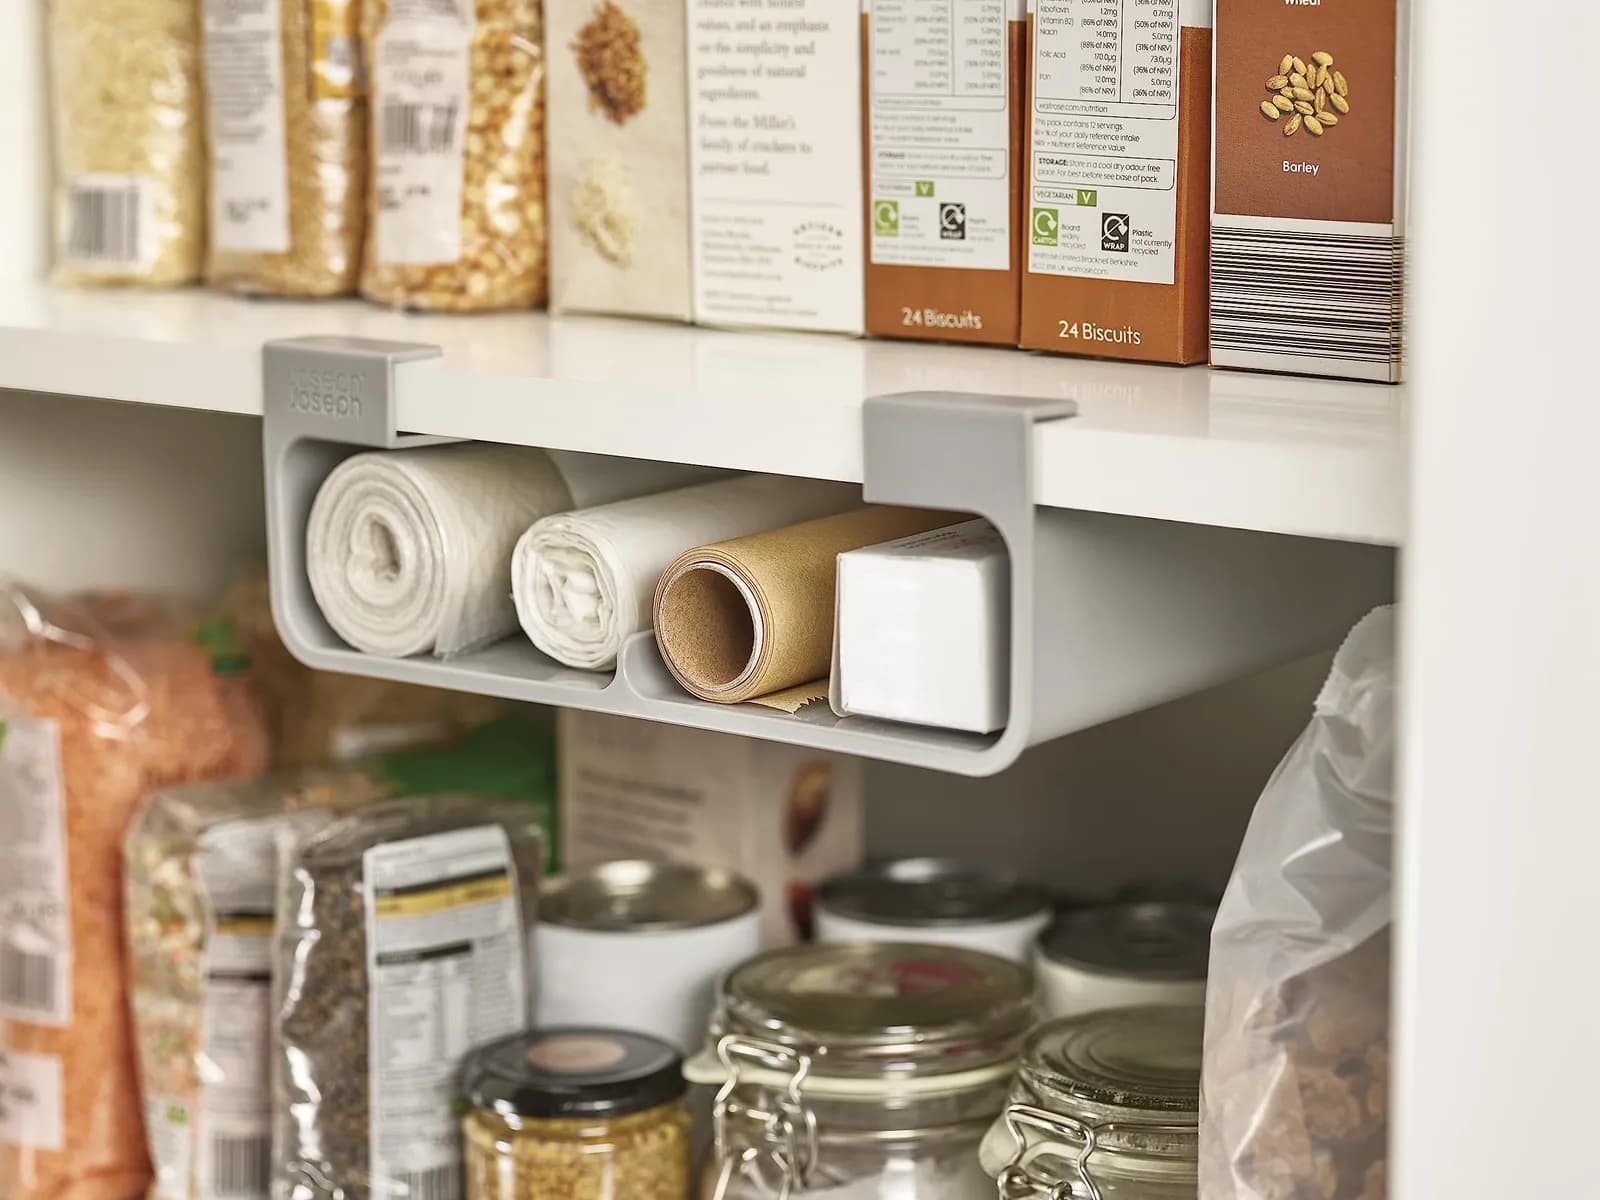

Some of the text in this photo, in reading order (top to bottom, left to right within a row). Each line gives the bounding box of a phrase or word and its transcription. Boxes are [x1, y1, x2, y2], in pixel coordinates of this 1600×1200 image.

[1158, 22, 1172, 30] NRV)
[1152, 33, 1172, 41] 5.0mg
[1157, 67, 1171, 75] NRV)
[1151, 78, 1171, 86] 5.0mg
[1156, 90, 1171, 98] NRV)
[1113, 163, 1124, 172] dry
[1125, 164, 1146, 172] odour
[1283, 161, 1319, 176] Barley
[1116, 174, 1132, 182] base
[1141, 175, 1158, 184] pack.
[1132, 229, 1153, 237] Plastic
[1103, 242, 1125, 250] WRAP
[1144, 239, 1172, 248] currently
[1132, 248, 1158, 256] recycled
[901, 307, 982, 329] 24 Biscuits
[1058, 320, 1141, 345] 24 Biscuits
